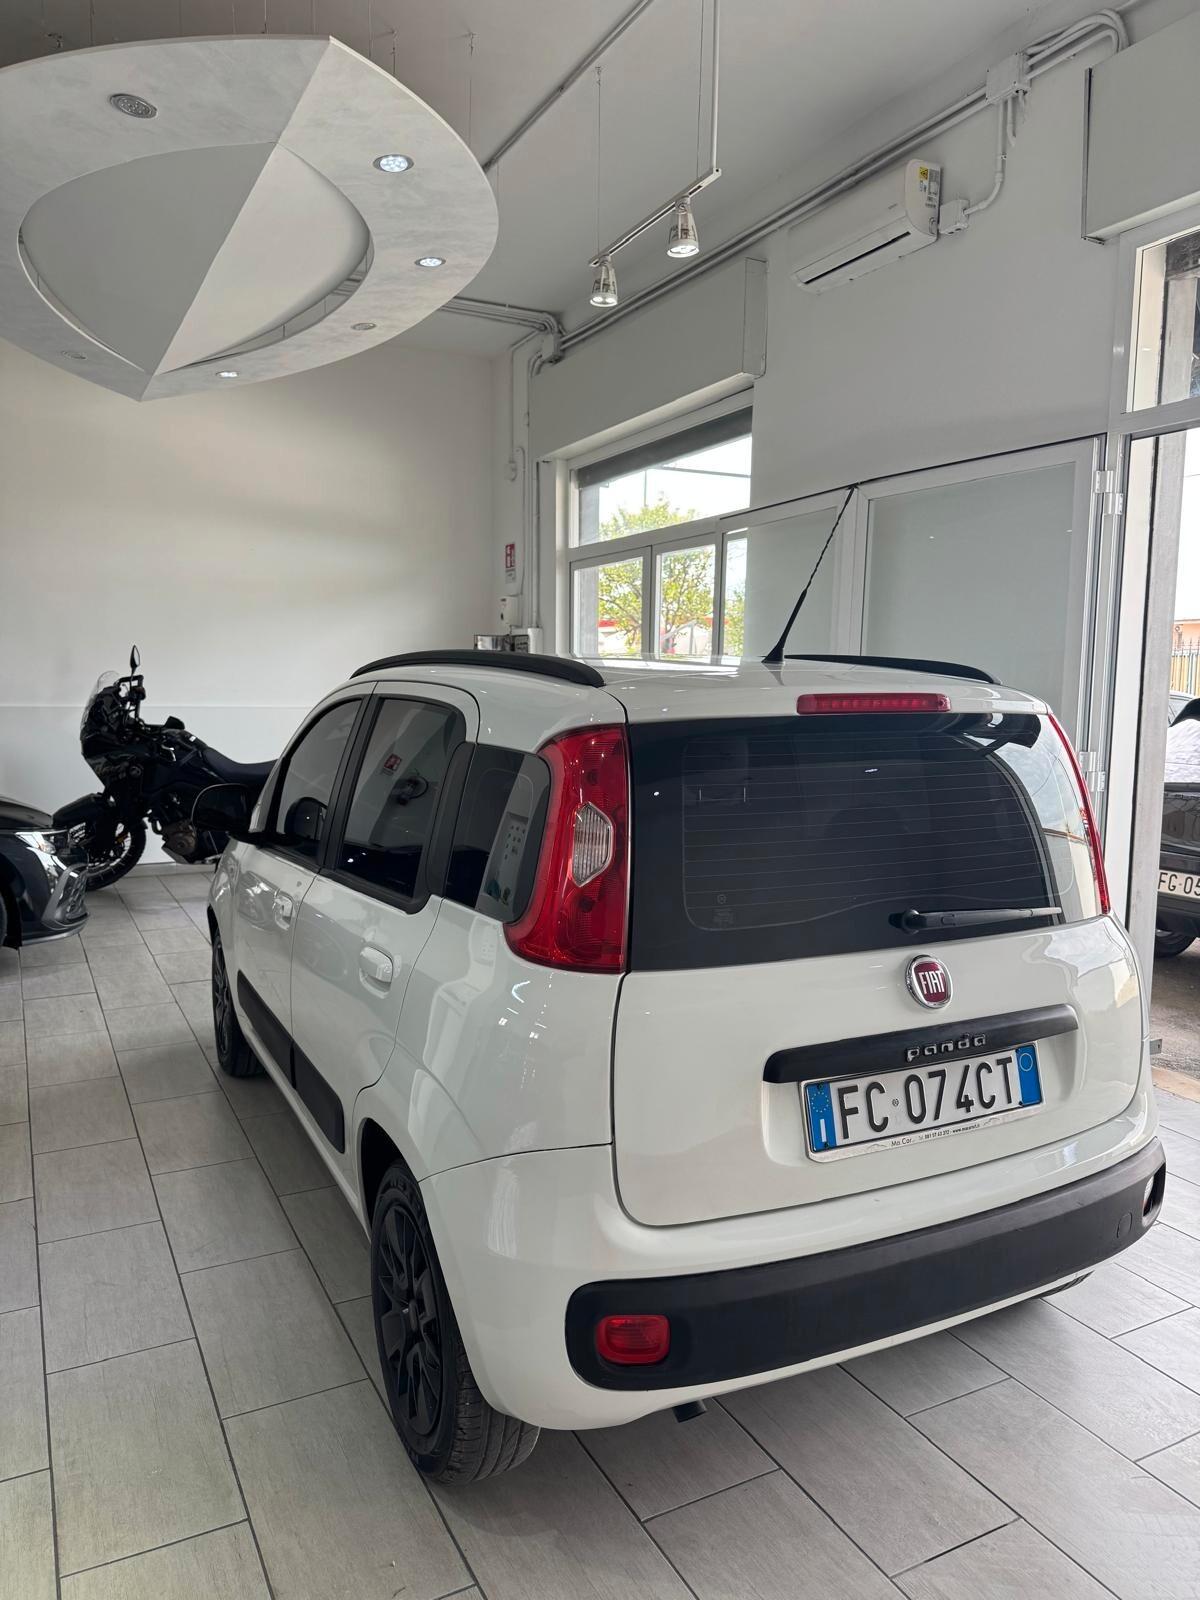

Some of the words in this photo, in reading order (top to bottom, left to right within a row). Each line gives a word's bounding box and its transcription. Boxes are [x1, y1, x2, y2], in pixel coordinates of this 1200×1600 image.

[1157, 871, 1178, 892] FG
[918, 970, 945, 994] FIAT
[906, 1033, 987, 1062] panda
[837, 1080, 889, 1140] FC
[904, 1055, 1013, 1125] 074CT
